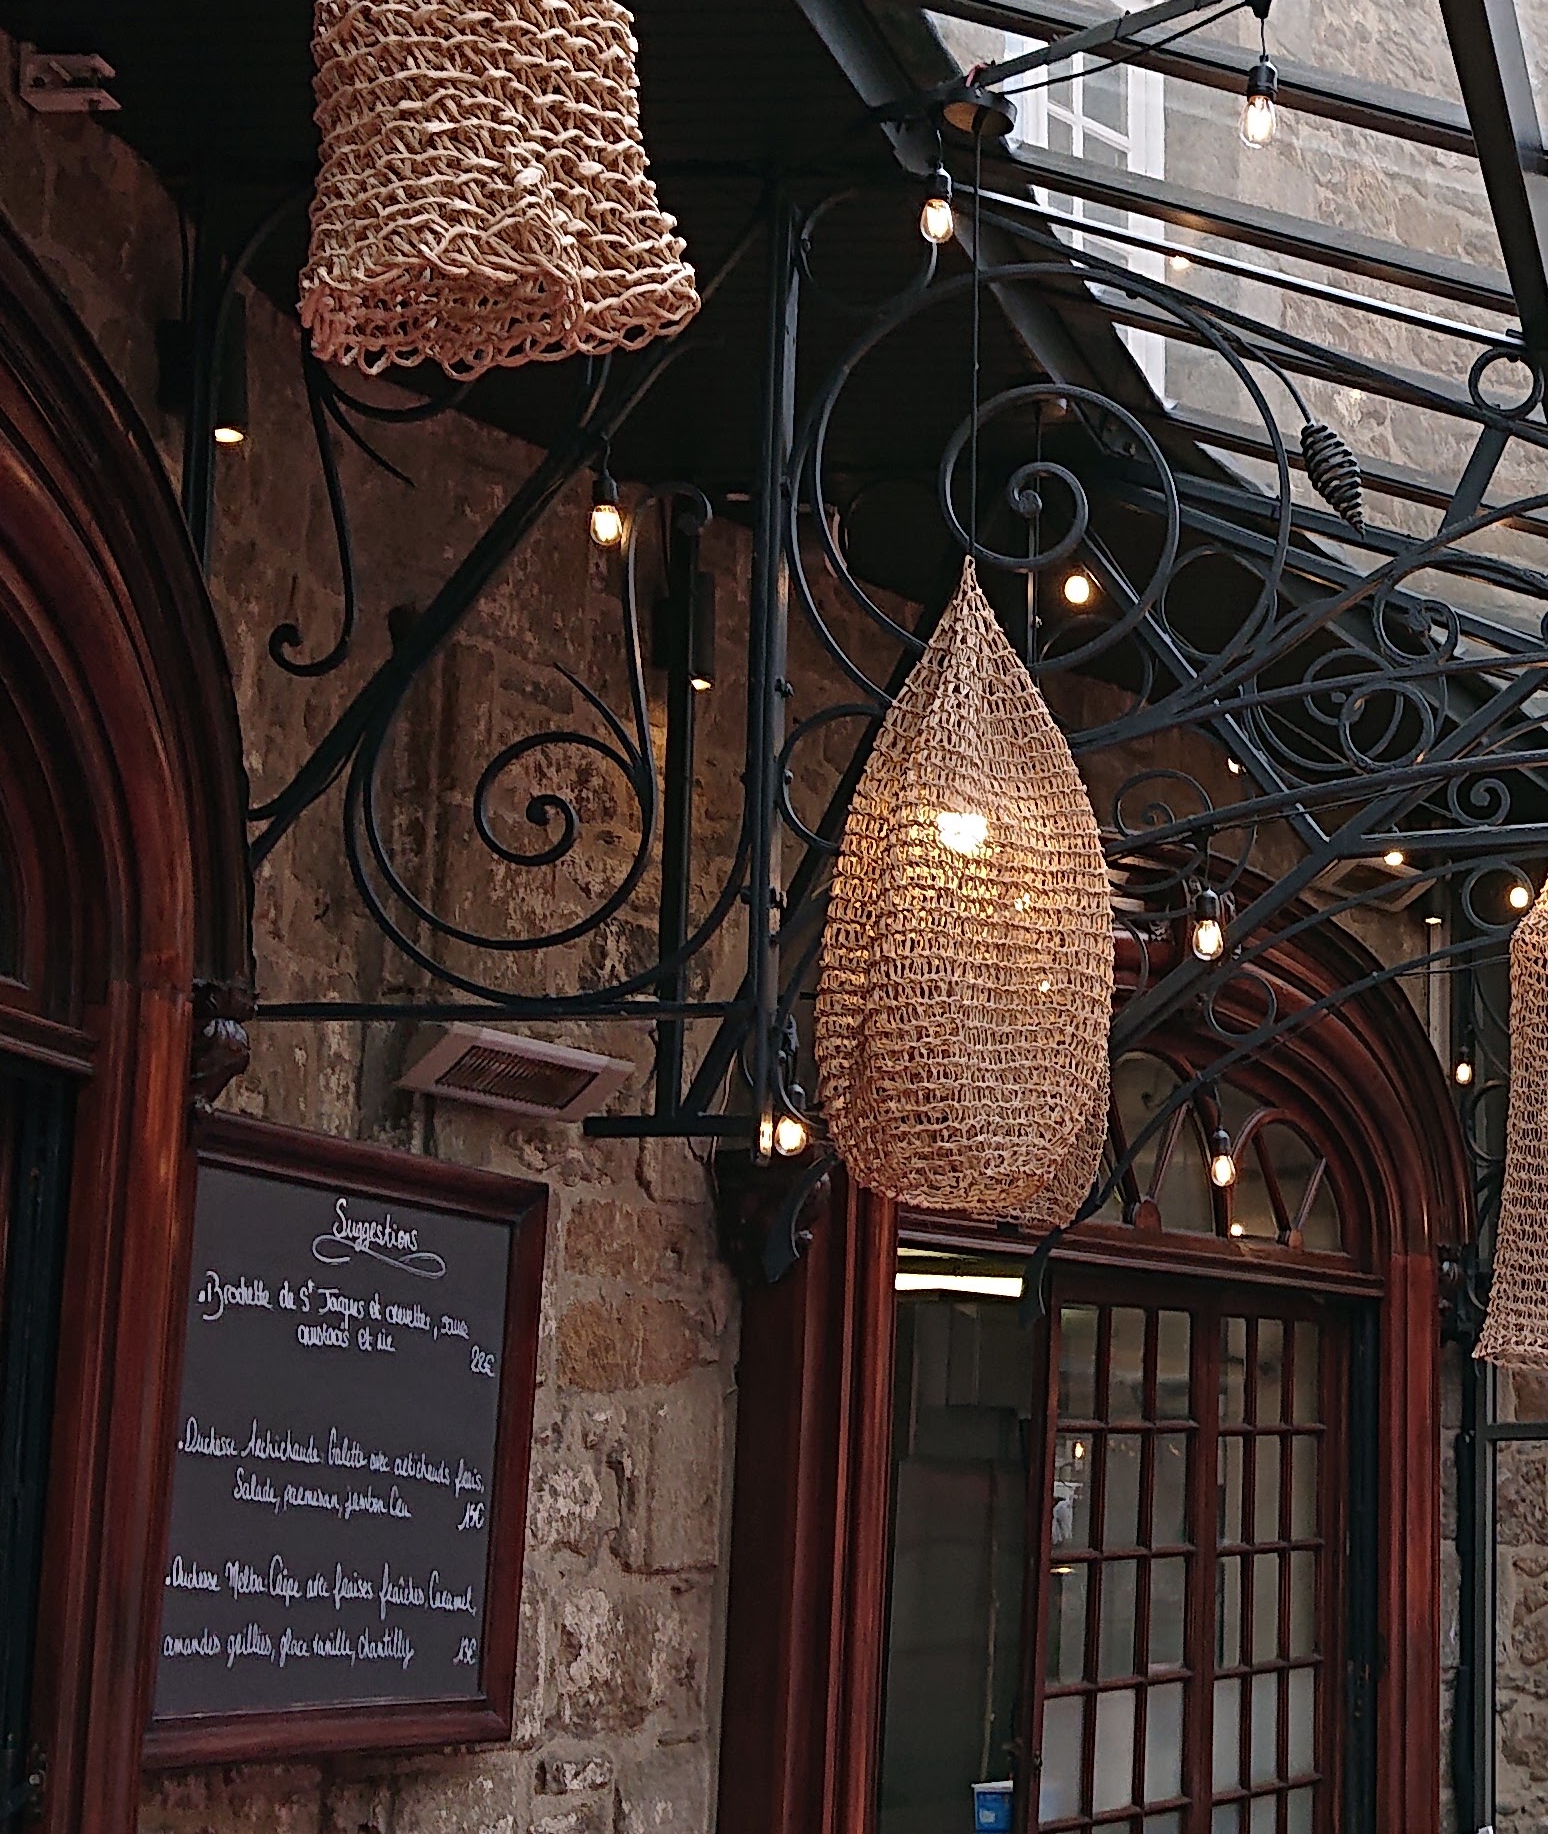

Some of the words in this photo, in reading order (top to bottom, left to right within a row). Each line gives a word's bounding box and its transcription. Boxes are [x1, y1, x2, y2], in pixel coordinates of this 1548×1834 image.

[332, 1197, 418, 1251] Suggestions
[202, 1270, 273, 1320] Brochette
[279, 1280, 297, 1310] de
[369, 1293, 382, 1320] et
[358, 1327, 373, 1351] et
[471, 1345, 495, 1377] 22€
[185, 1416, 237, 1456] Duchesse
[328, 1427, 367, 1468] Galette
[345, 1485, 387, 1520] jambon
[457, 1502, 485, 1531] 15€
[172, 1555, 221, 1592] Duchesse
[332, 1562, 373, 1610] fraises
[163, 1627, 221, 1656] amandes
[279, 1627, 310, 1668] glace
[357, 1626, 415, 1670] chantilly
